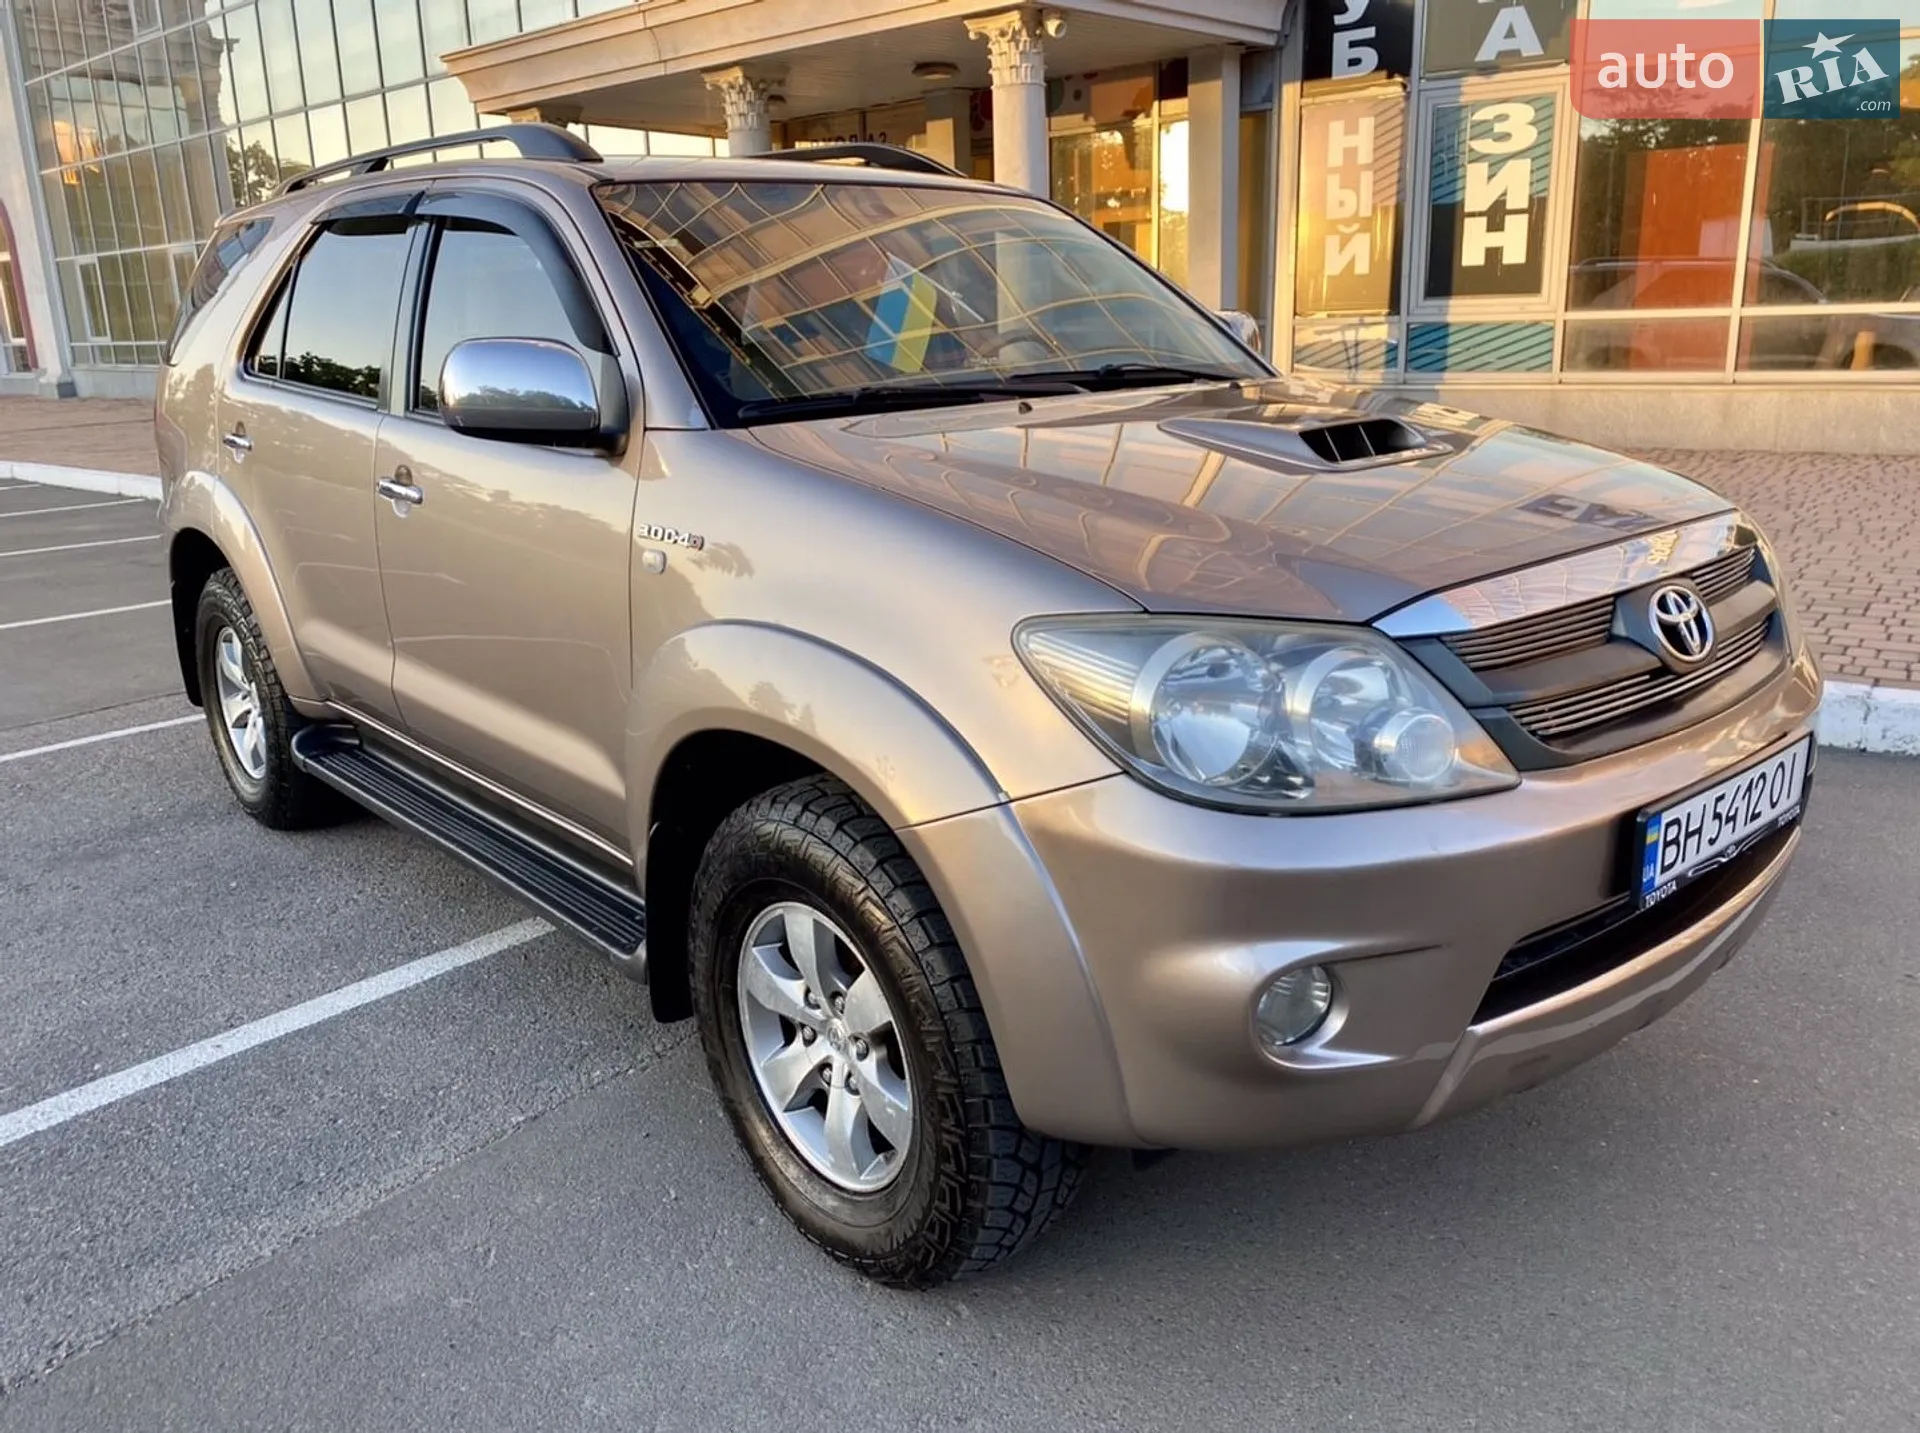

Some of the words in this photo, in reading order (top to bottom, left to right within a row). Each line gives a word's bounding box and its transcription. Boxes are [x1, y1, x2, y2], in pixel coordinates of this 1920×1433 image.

[1461, 0, 1545, 267] АЗИН
[1660, 803, 1707, 876] BH
[1707, 771, 1767, 847] 5412
[1645, 879, 1678, 908] TOYOTA
